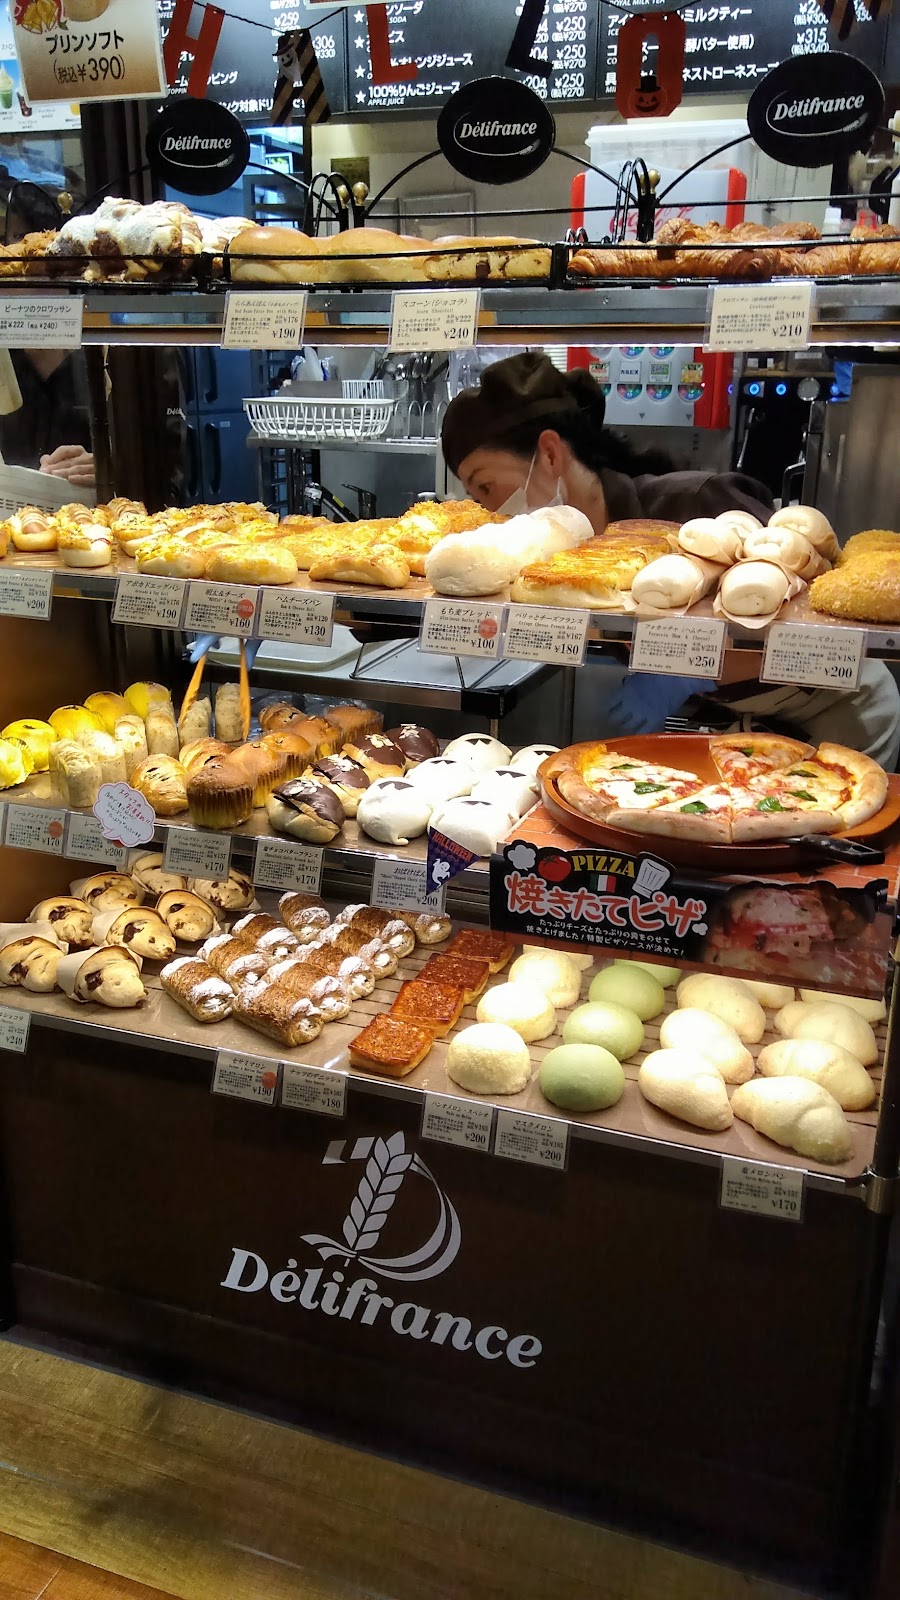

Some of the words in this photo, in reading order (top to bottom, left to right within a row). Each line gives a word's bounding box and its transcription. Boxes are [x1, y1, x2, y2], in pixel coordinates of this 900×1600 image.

[388, 16, 407, 24] SODA
[556, 15, 587, 33] ¥250
[796, 27, 828, 44] ¥315
[46, 30, 124, 54] プリンソフト
[556, 44, 587, 60] ¥250
[554, 72, 585, 89] ¥250
[367, 81, 461, 99] 100%りんごジュース
[367, 97, 387, 106] APPLE
[387, 97, 405, 105] JUICE
[773, 94, 865, 121] Délifrance
[459, 120, 538, 139] Délifrance
[164, 135, 232, 152] Délifrance
[272, 328, 296, 339] ¥190
[444, 328, 469, 339] ¥240
[771, 325, 802, 337] ¥210
[27, 600, 46, 610] ¥200
[157, 609, 177, 619] ¥190
[441, 607, 492, 618] もち麦ブレッド
[229, 617, 251, 629] ¥160
[304, 625, 326, 637] ¥130
[470, 637, 495, 650] ¥100
[554, 643, 579, 655] ¥180
[688, 655, 715, 668] ¥250
[824, 665, 853, 678] ¥200
[42, 837, 60, 847] ¥170
[431, 831, 473, 861] HALLOWEEN
[105, 848, 123, 858] ¥200
[204, 862, 224, 872] ¥170
[571, 854, 637, 878] PIZZA
[296, 874, 316, 886] ¥170
[416, 895, 438, 907] ¥200
[504, 871, 707, 937] 焼きたてピザ
[252, 1085, 272, 1097] ¥190
[321, 1098, 341, 1109] ¥180
[464, 1132, 486, 1144] ¥200
[540, 1149, 561, 1162] ¥200
[771, 1199, 797, 1212] ¥170
[220, 1247, 543, 1368] Délifrance
